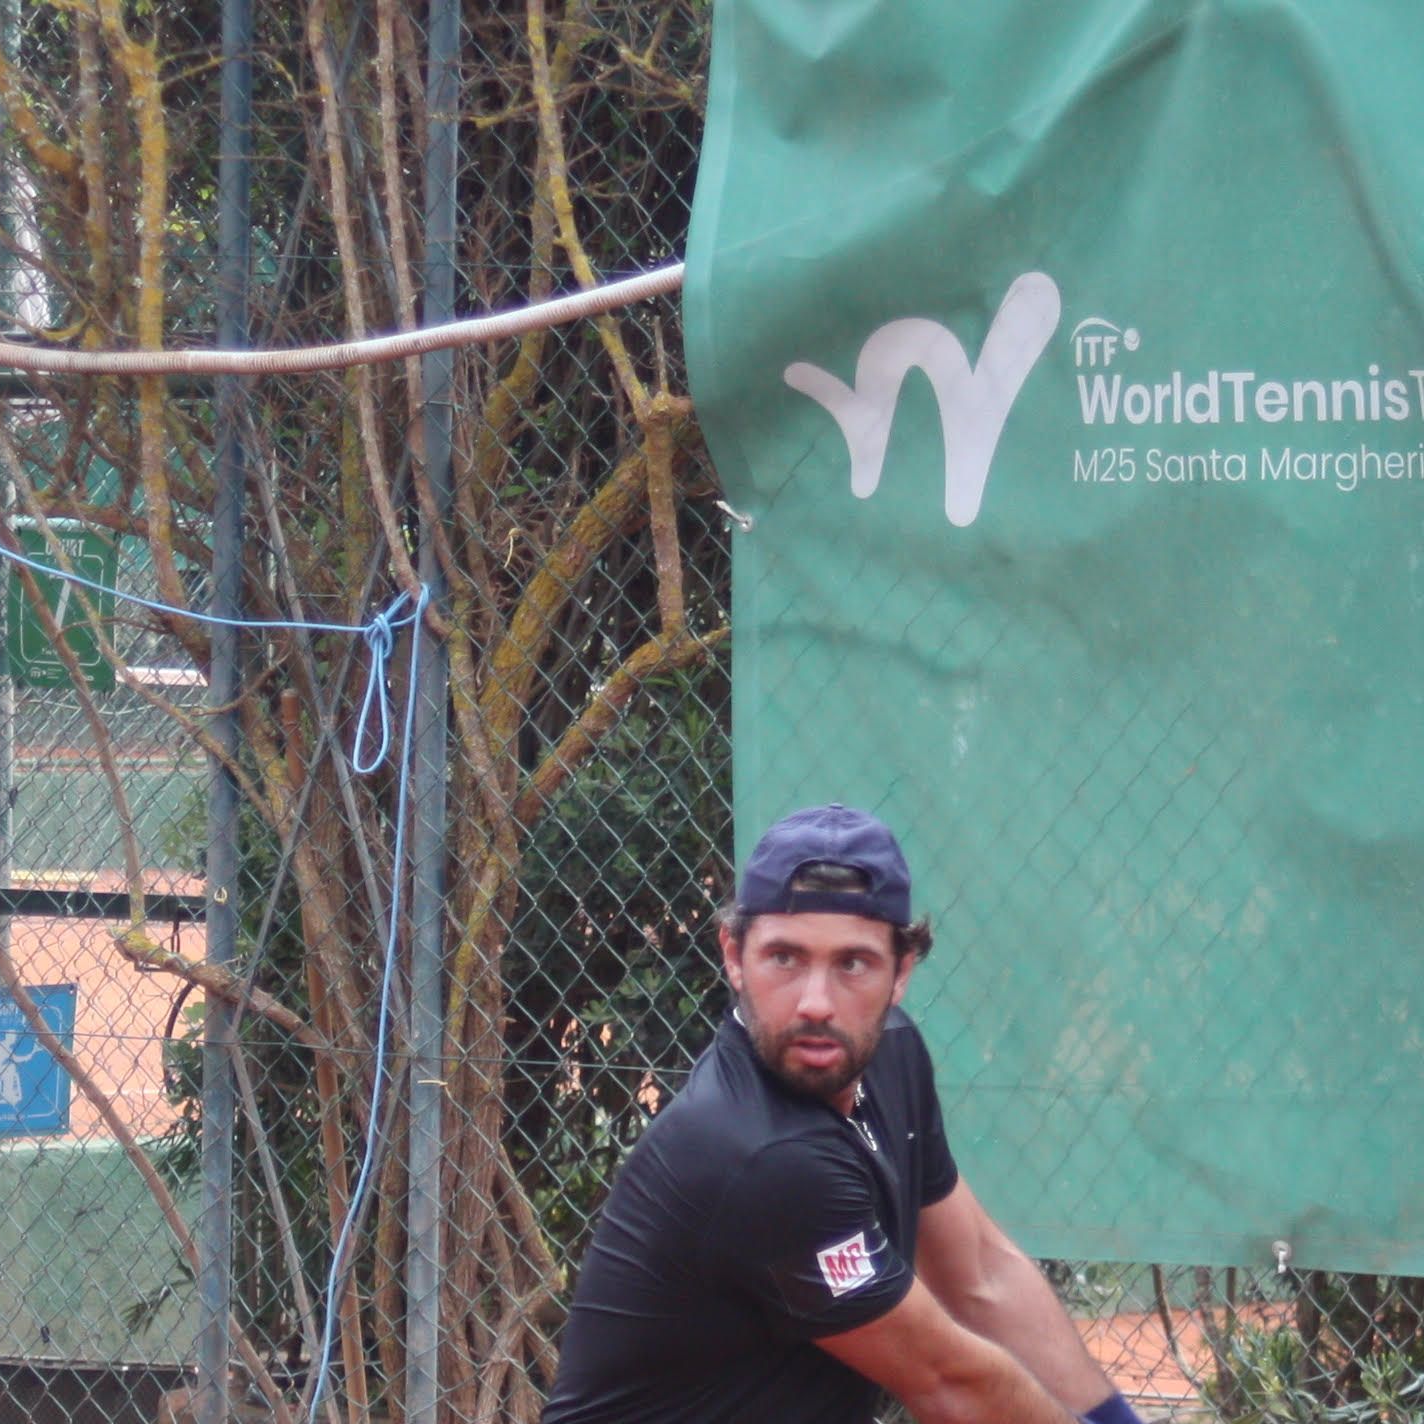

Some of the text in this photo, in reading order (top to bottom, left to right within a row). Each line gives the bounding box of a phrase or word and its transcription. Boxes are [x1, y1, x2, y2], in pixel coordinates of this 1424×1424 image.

[1076, 336, 1118, 367] ITF
[1073, 448, 1136, 482] M25
[1145, 447, 1247, 482] Santa
